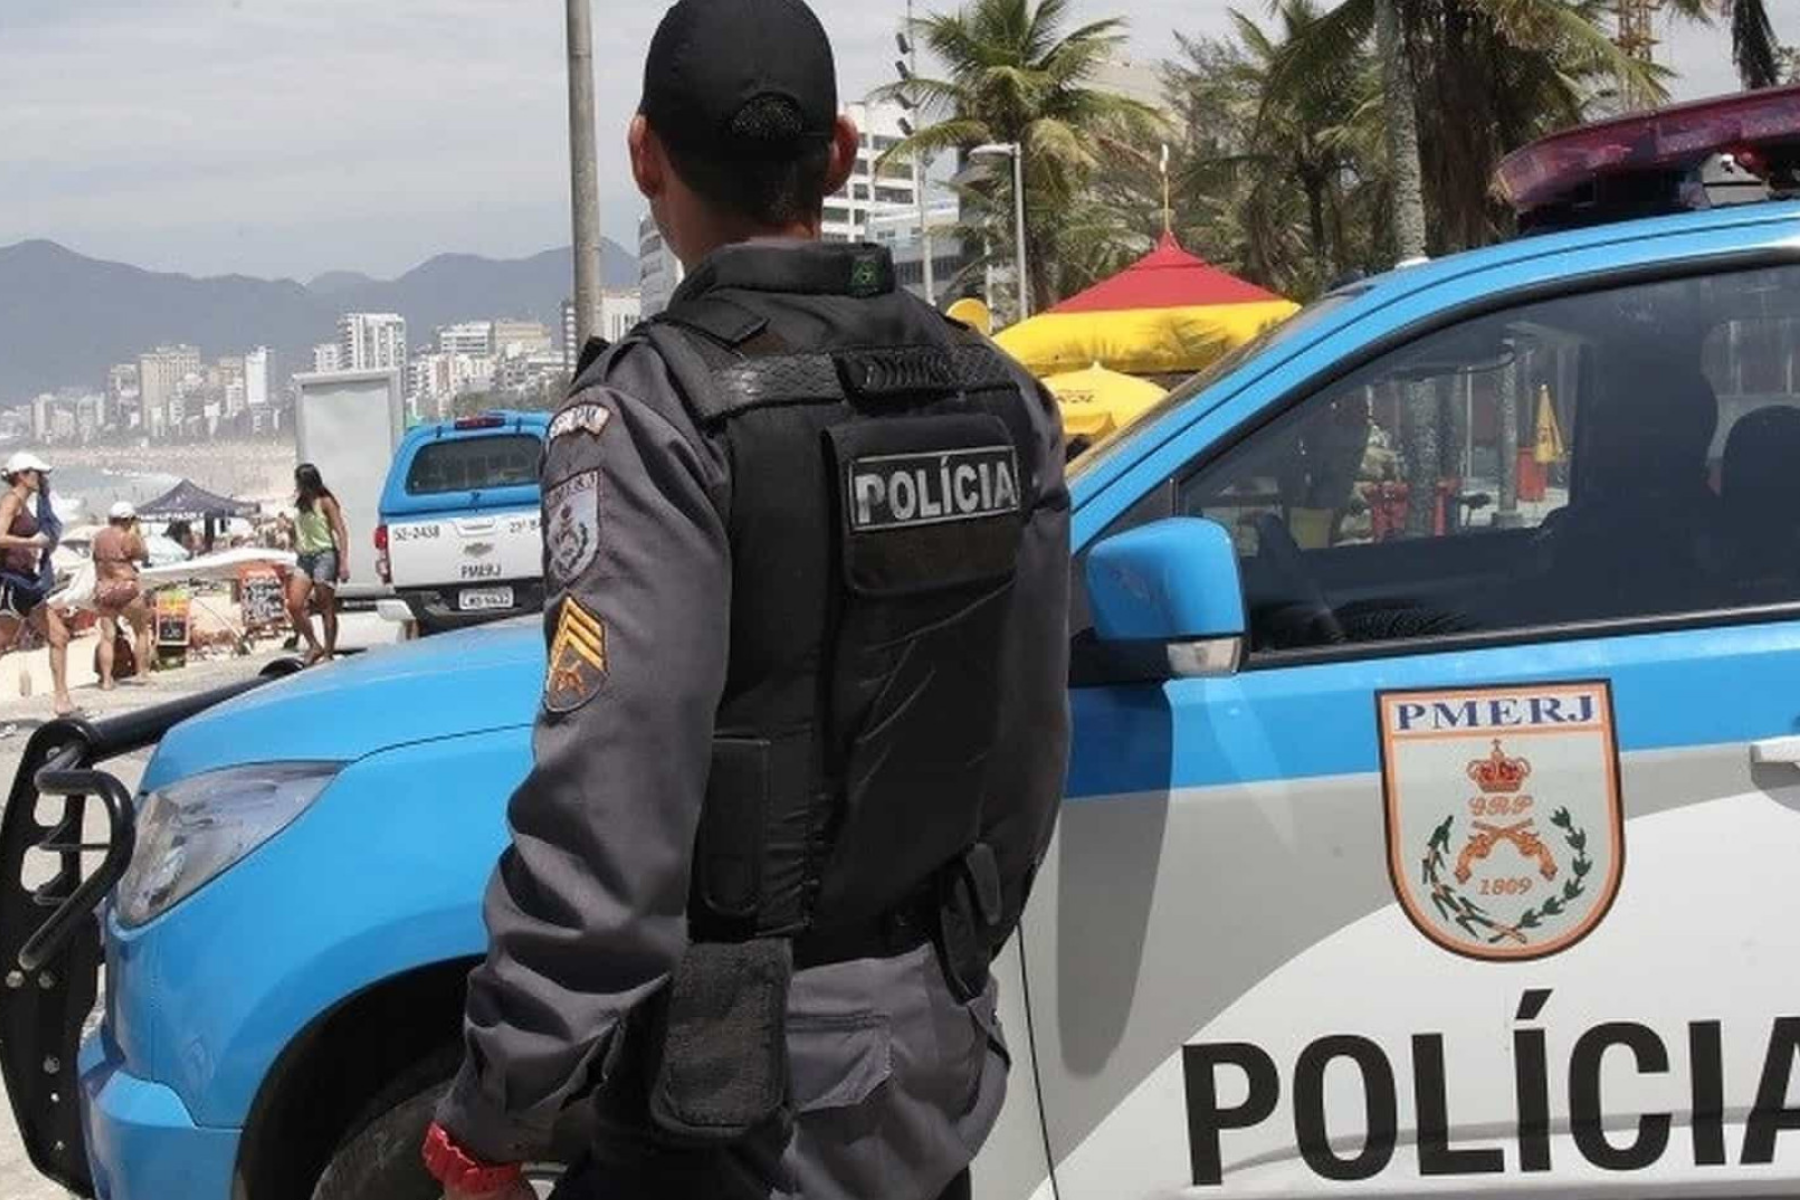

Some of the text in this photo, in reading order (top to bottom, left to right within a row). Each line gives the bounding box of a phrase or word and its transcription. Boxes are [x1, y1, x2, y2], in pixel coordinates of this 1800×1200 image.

[854, 455, 1018, 524] POLÍCIA
[1397, 695, 1594, 731] PMERJ
[1479, 877, 1532, 896] 1809
